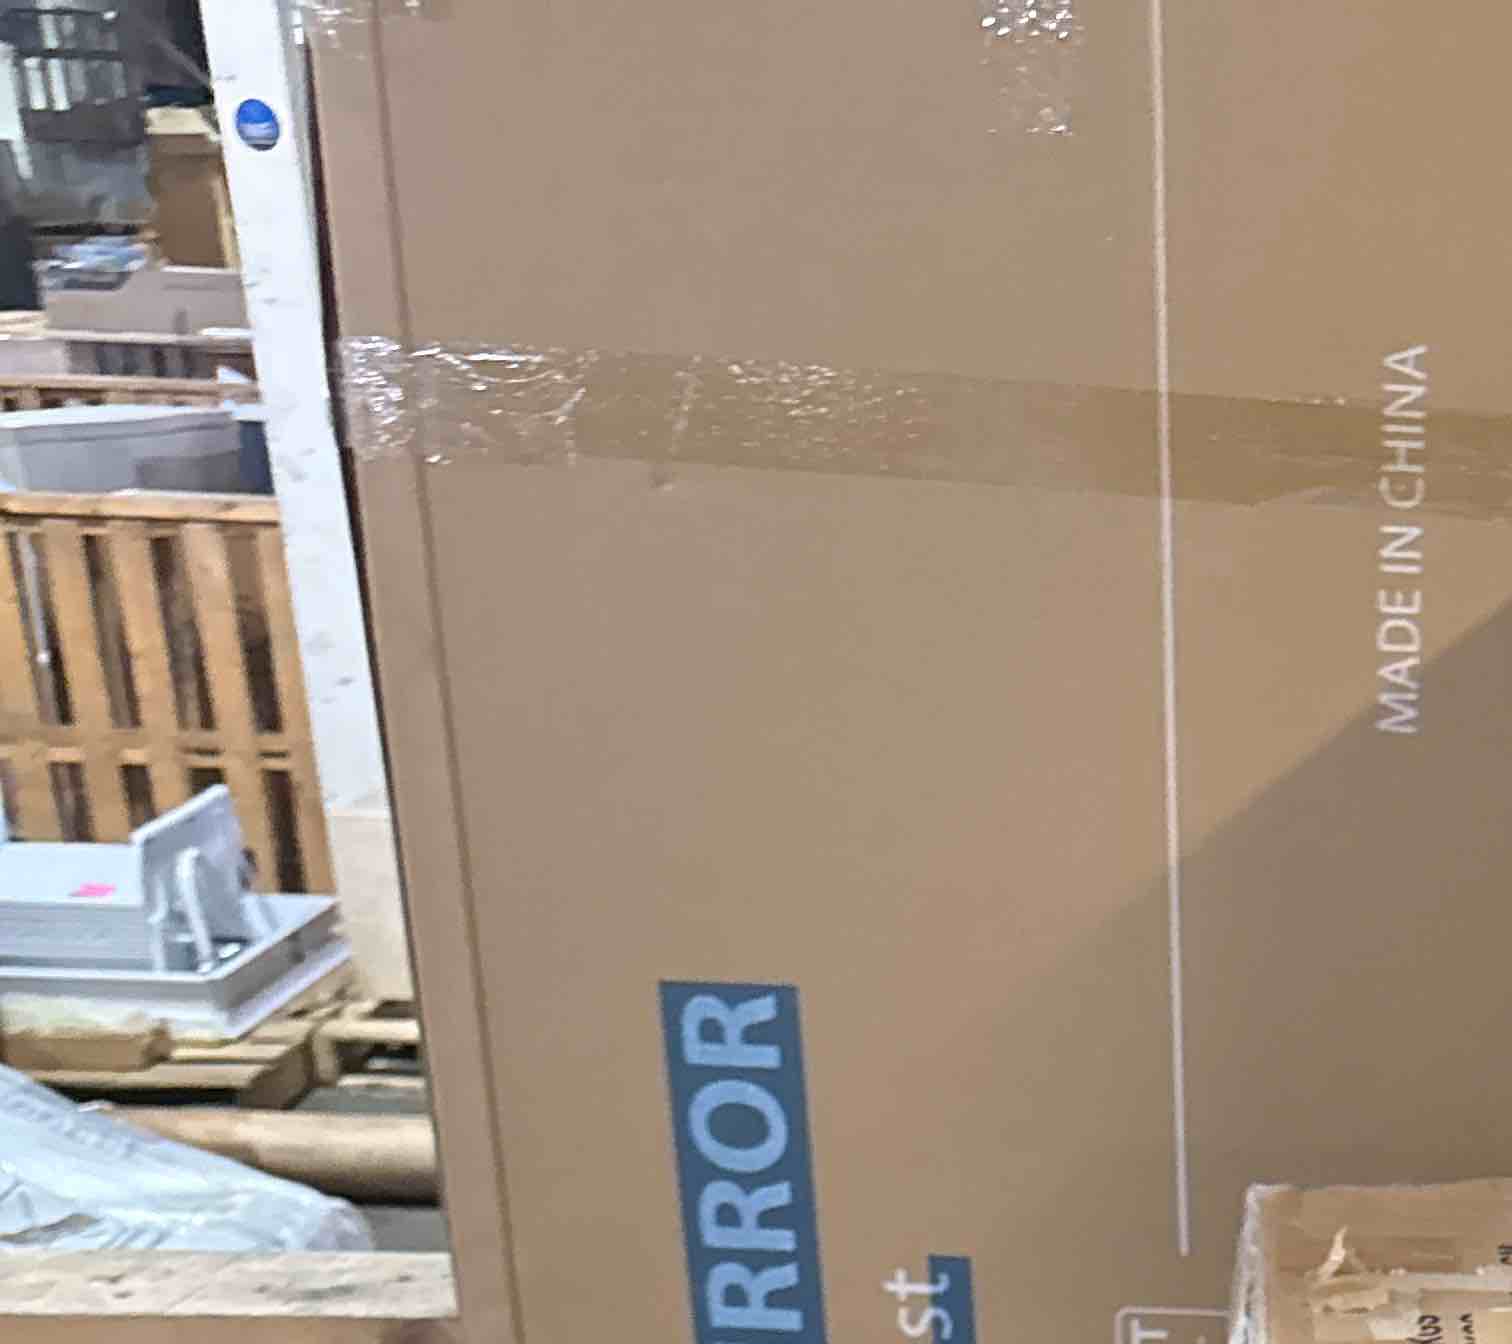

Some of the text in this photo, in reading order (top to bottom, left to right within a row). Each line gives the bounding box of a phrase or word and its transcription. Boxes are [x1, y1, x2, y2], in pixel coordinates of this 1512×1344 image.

[1375, 344, 1428, 734] MADE IN CHINA
